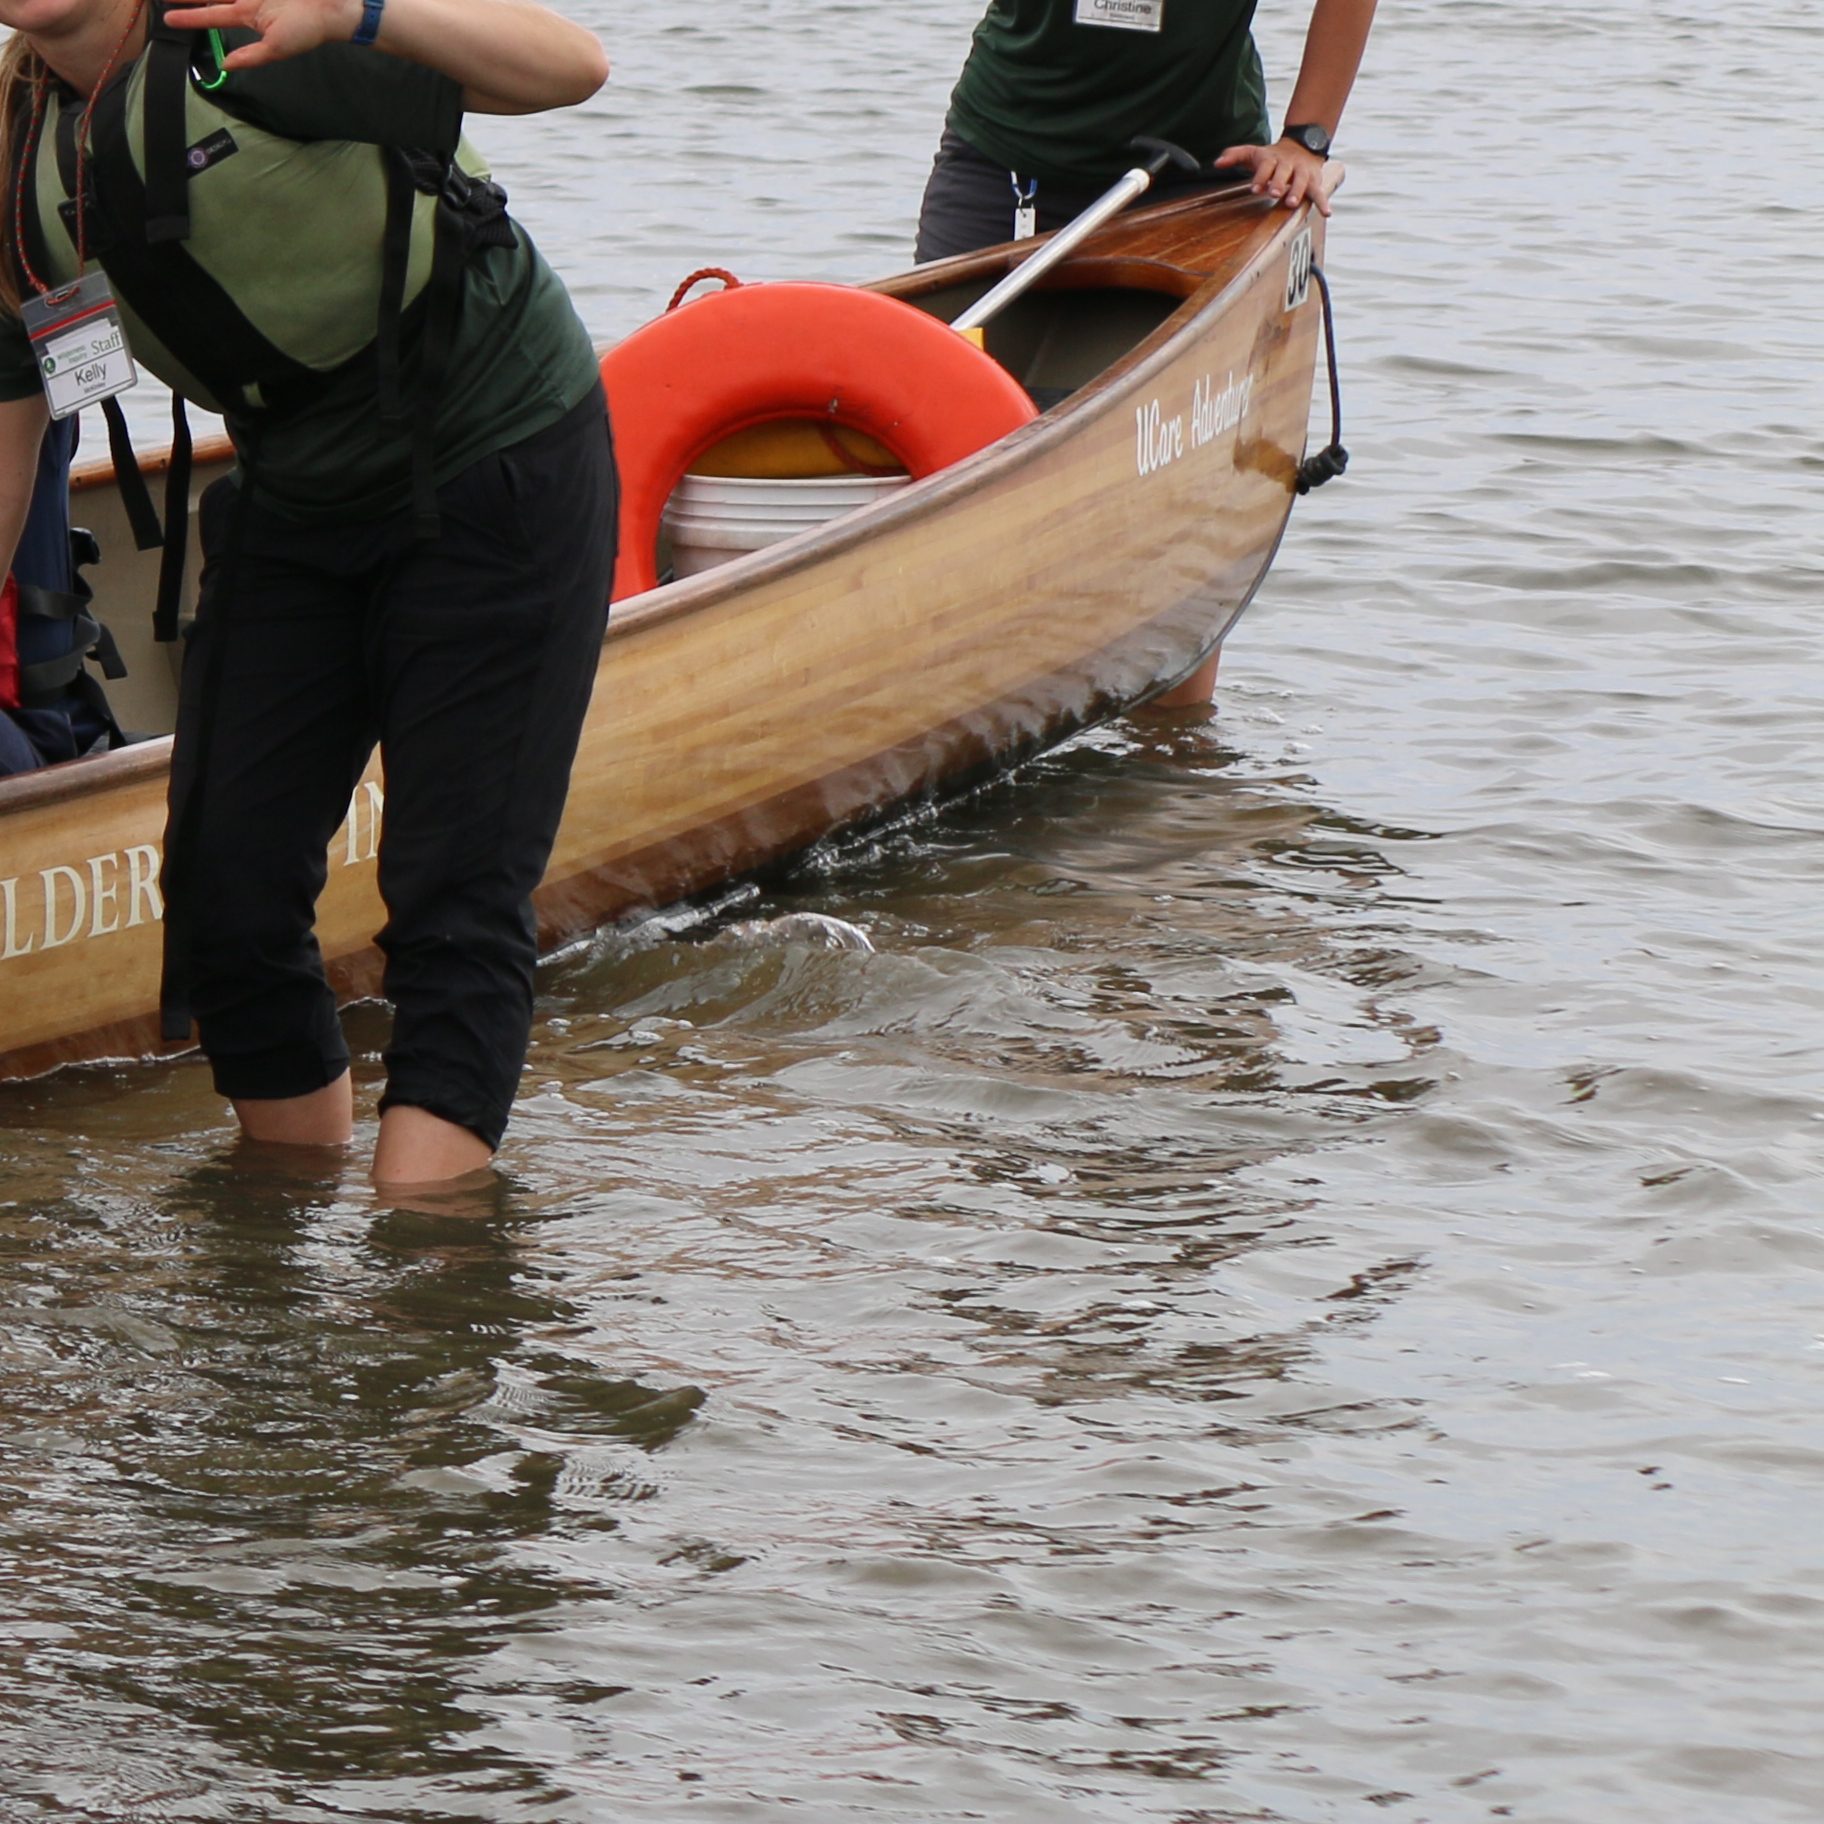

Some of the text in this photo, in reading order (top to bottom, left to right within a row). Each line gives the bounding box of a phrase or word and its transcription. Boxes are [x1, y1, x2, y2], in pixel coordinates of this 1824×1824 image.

[1288, 232, 1309, 306] 30
[91, 331, 121, 356] Staff
[74, 363, 107, 387] Kelly
